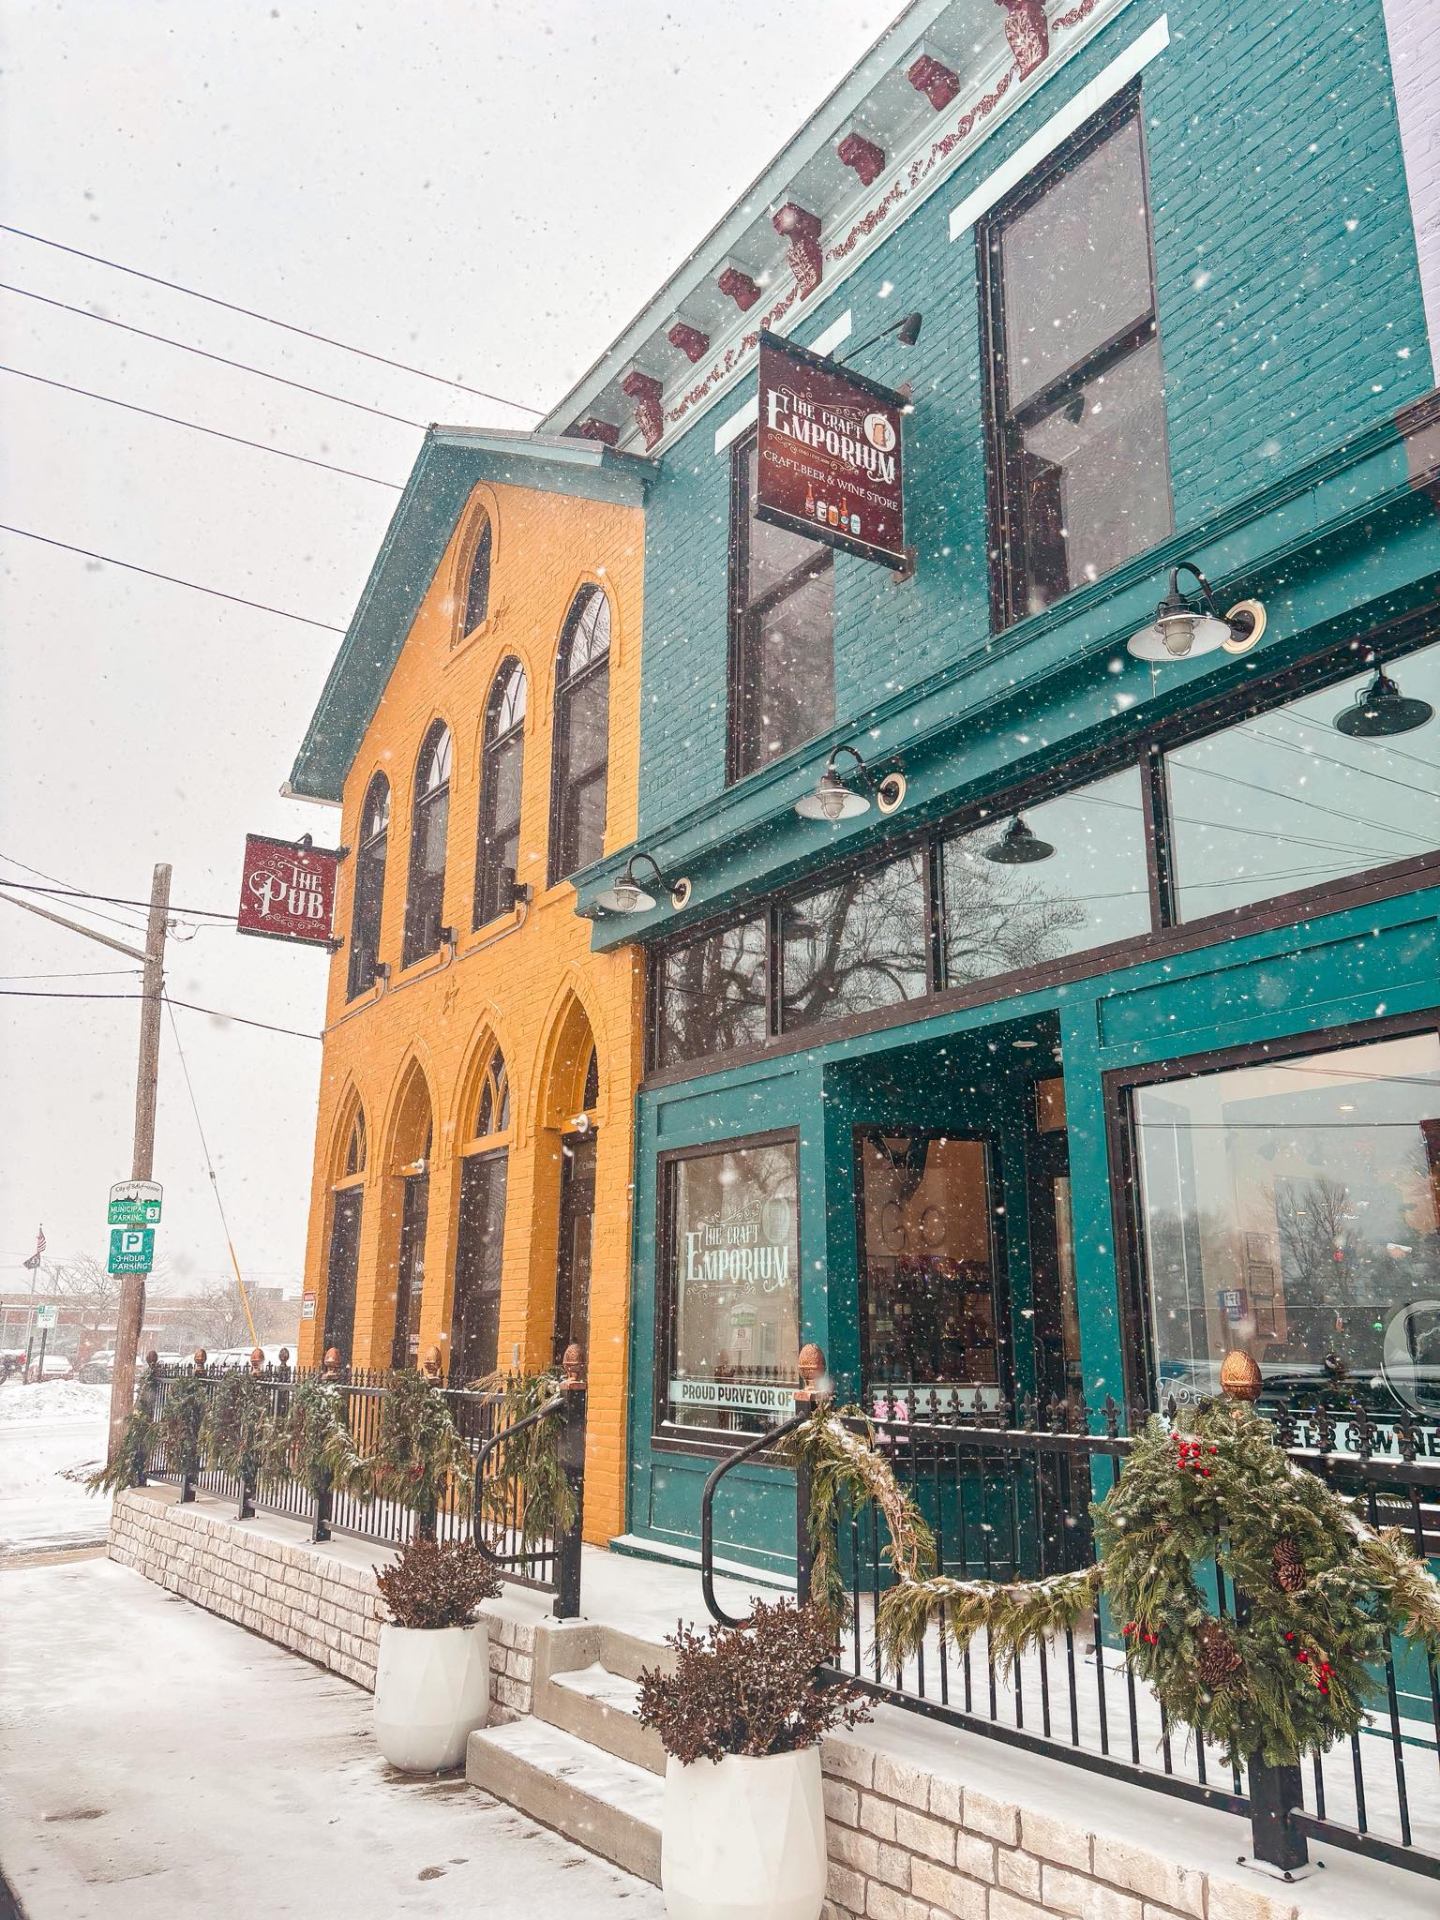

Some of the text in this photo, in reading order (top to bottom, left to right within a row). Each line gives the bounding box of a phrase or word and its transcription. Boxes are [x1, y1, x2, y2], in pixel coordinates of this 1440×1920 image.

[788, 391, 863, 439] THE CRAFT
[766, 388, 896, 485] EMPORIUM
[762, 449, 799, 471] CRAFT
[800, 464, 827, 483] BEER
[827, 474, 836, 486] &
[836, 478, 866, 498] WINE
[866, 490, 899, 511] STORE
[287, 865, 322, 892] THE
[249, 871, 324, 919] PUB
[110, 1205, 156, 1218] MUNICIPAL 3
[112, 1213, 143, 1222] PARKING
[126, 1234, 140, 1251] P
[705, 1223, 759, 1246] THE CRAFT
[112, 1262, 148, 1270] PARKING
[115, 1254, 145, 1262] 3-HOUR
[685, 1231, 790, 1292] EMPORIUM
[682, 1384, 793, 1407] PROUD PURVEYOR OF
[1273, 1424, 1337, 1450] EER
[1370, 1428, 1440, 1456] WNE
